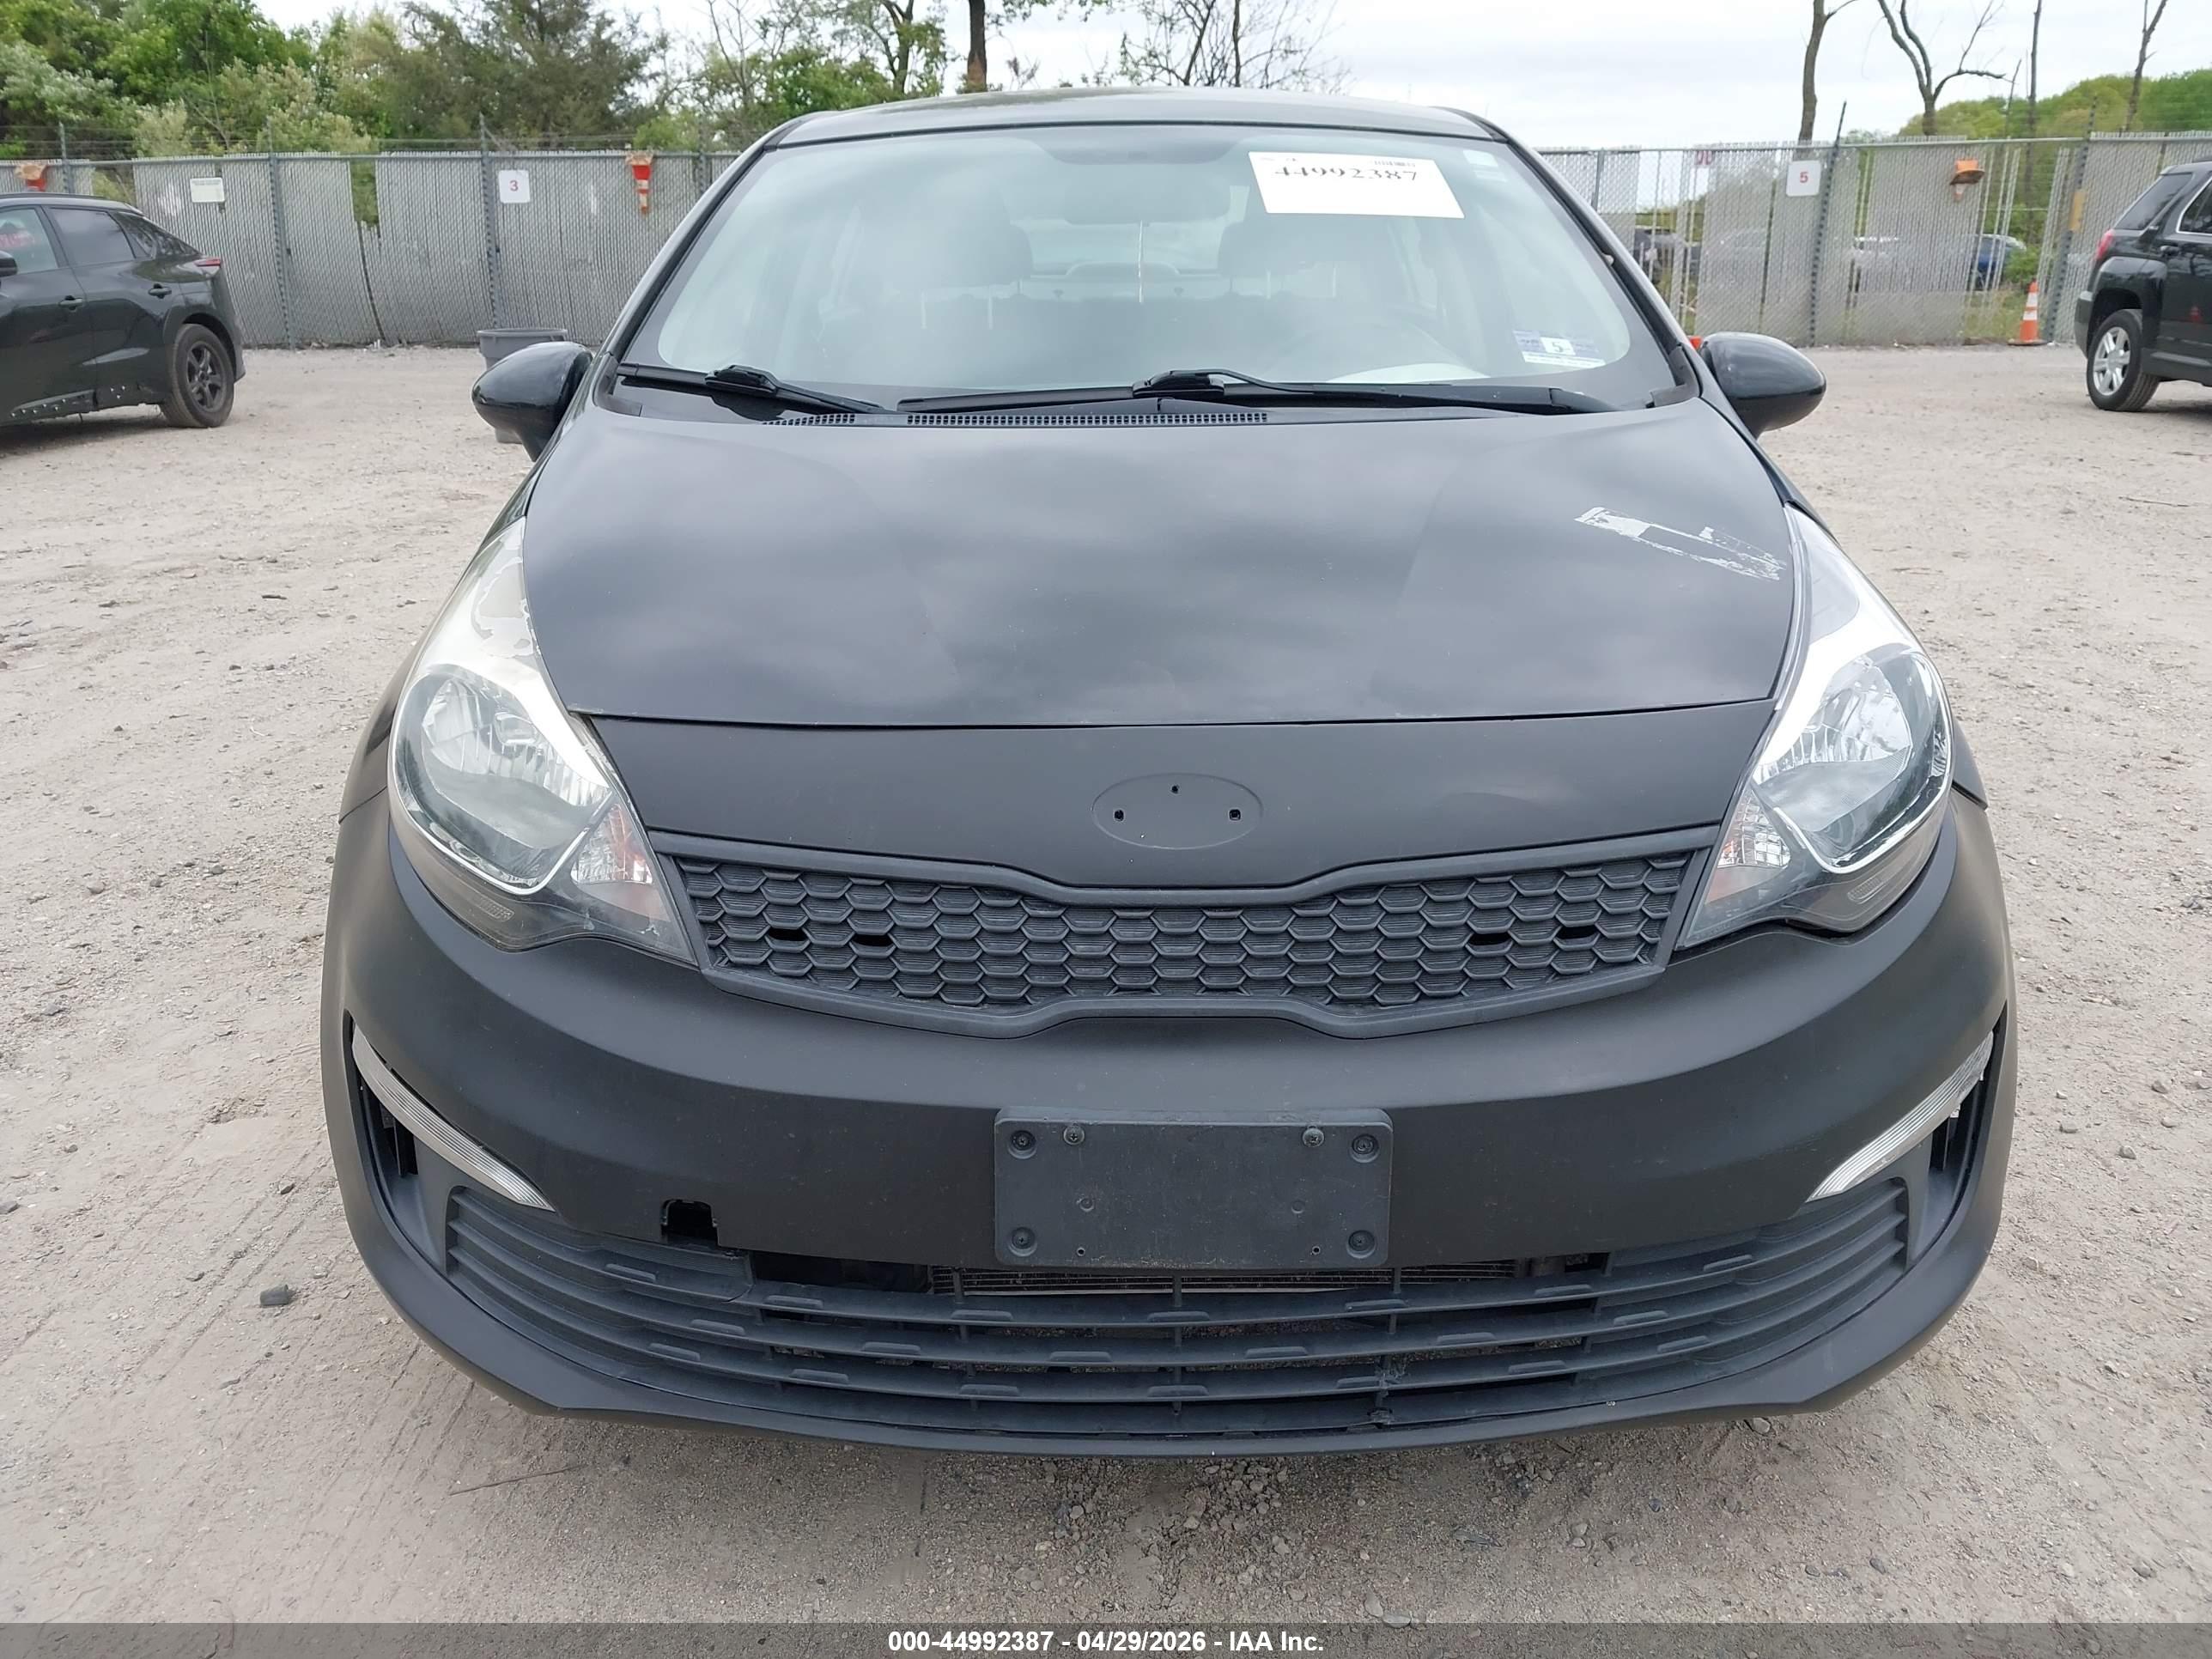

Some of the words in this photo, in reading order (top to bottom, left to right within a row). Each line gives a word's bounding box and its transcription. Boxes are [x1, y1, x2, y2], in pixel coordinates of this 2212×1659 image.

[1275, 166, 1416, 180] 44992387
[1799, 172, 1808, 183] 5
[510, 179, 519, 191] 3
[1552, 341, 1564, 353] 5
